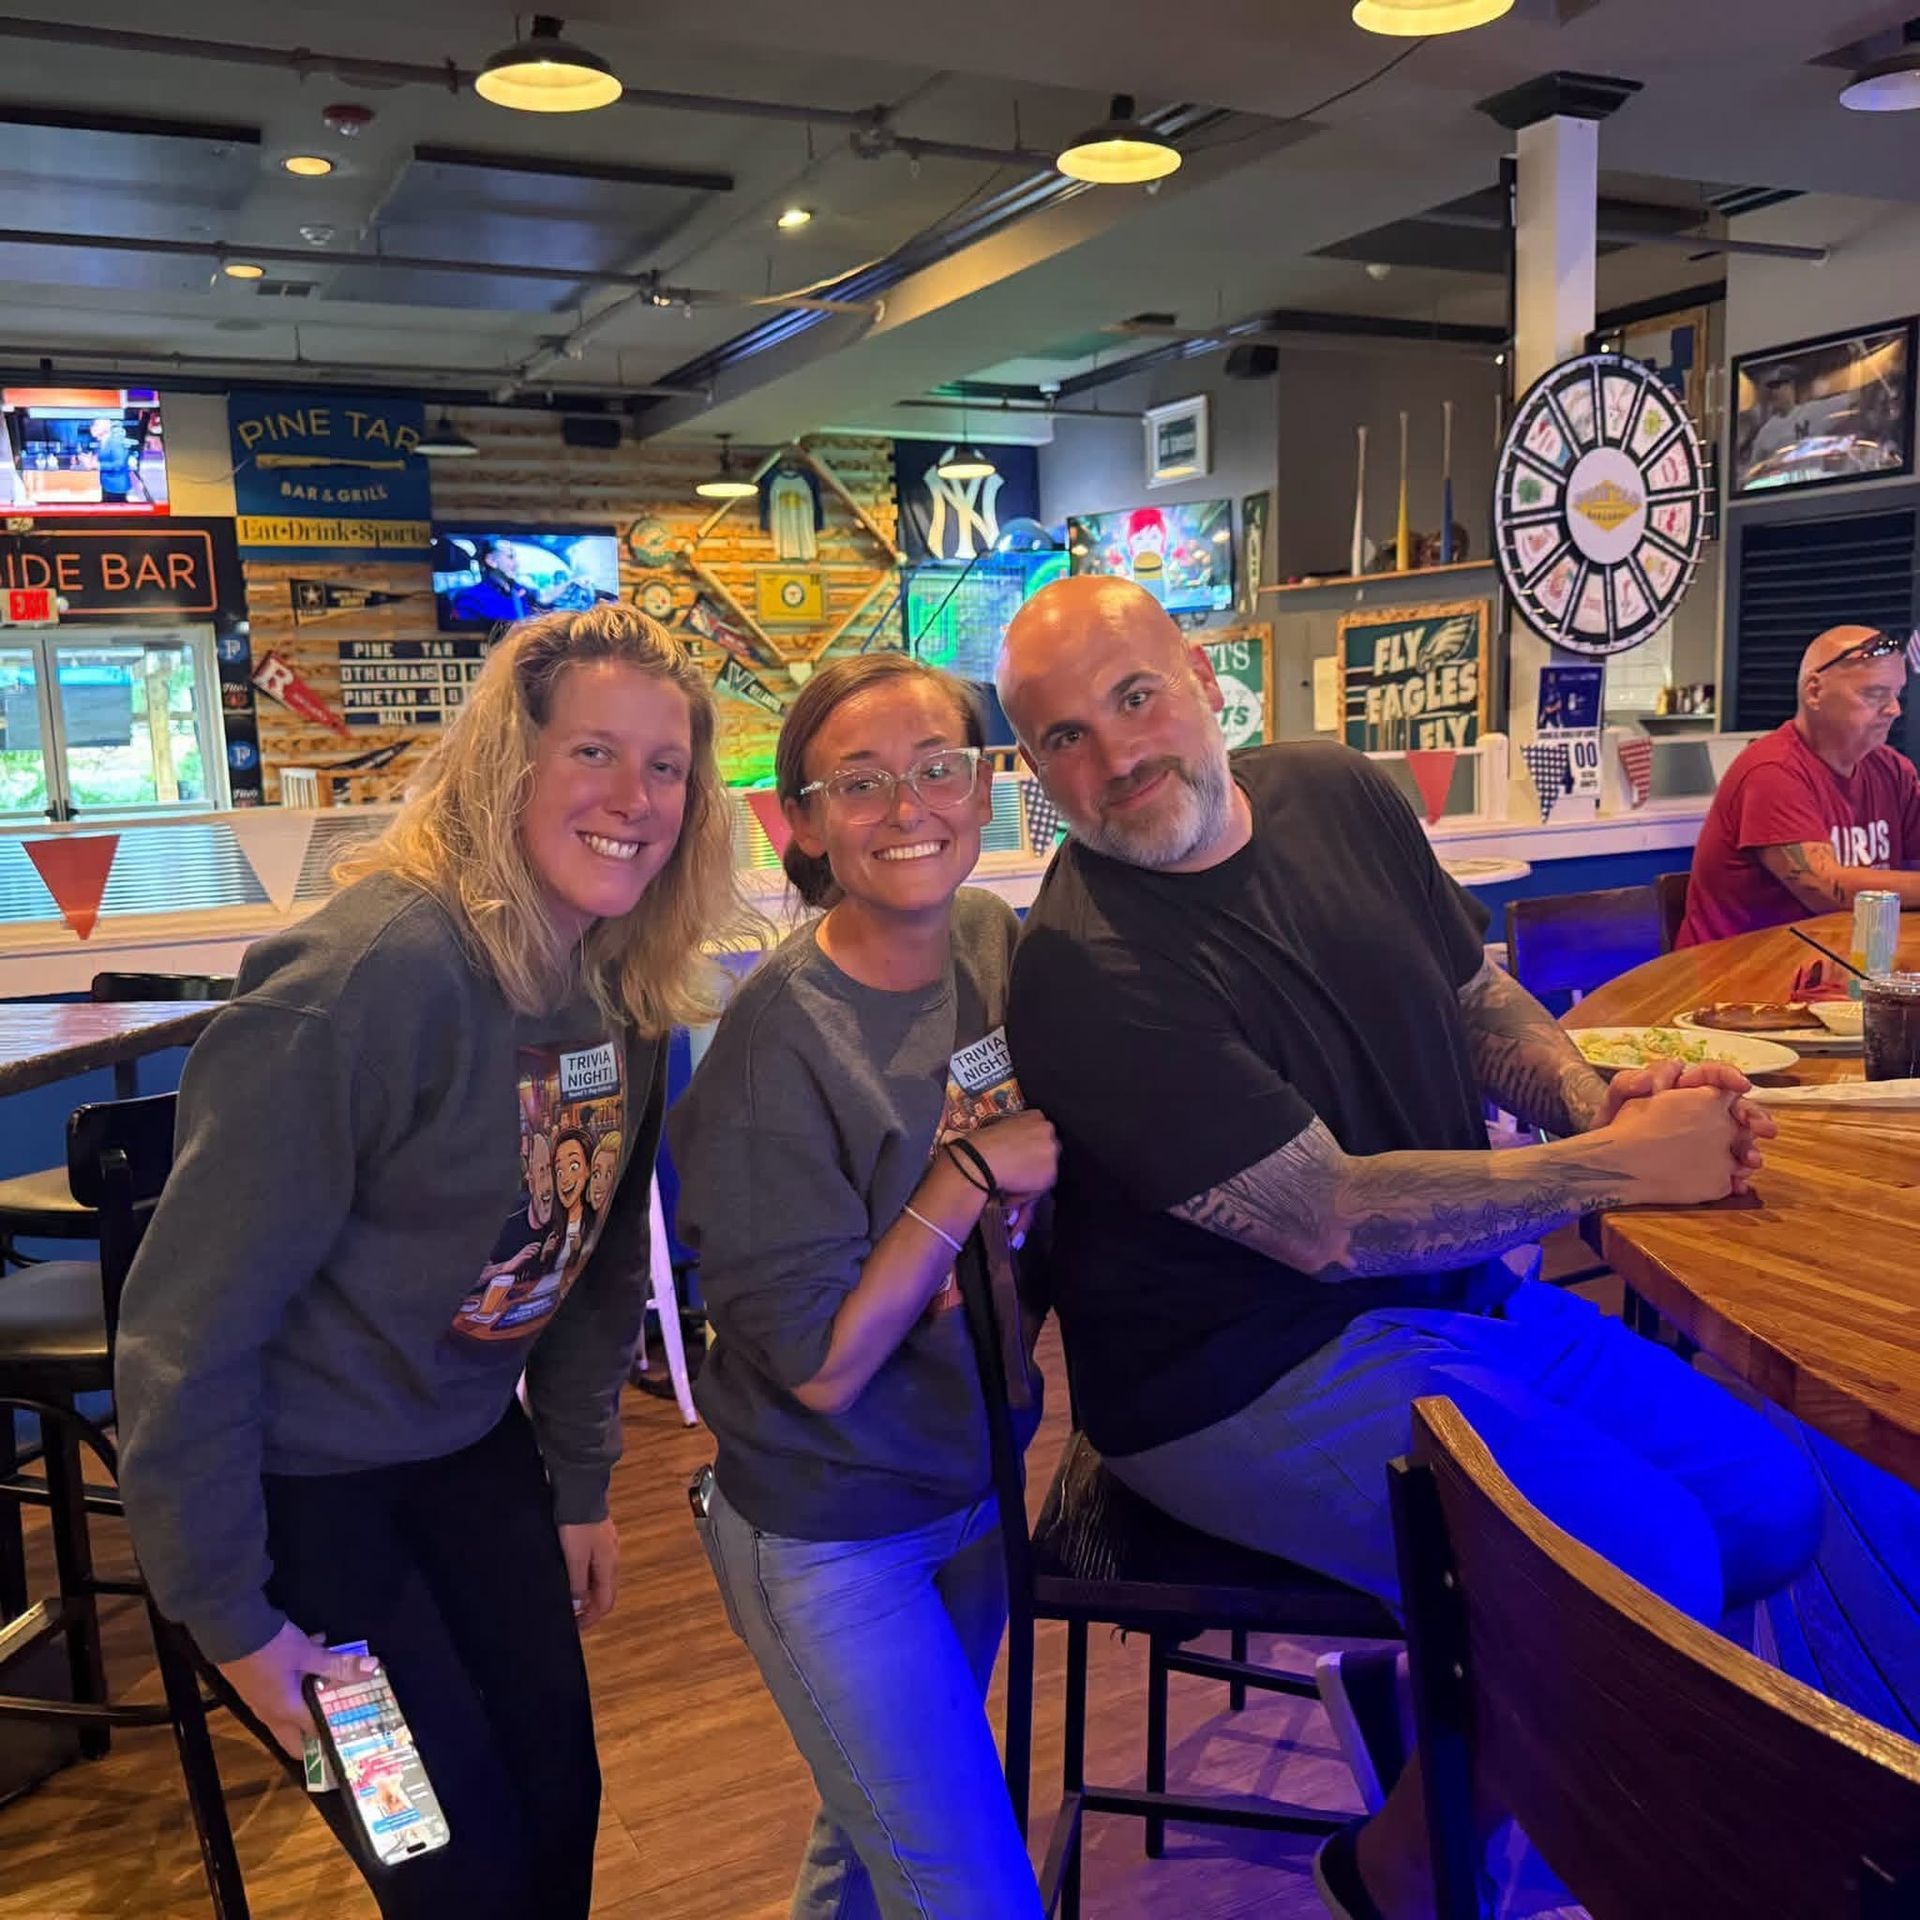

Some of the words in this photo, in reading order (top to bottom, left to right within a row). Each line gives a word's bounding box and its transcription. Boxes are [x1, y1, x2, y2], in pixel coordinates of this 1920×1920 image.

[238, 409, 331, 449] PINE
[344, 411, 421, 455] TAR
[281, 481, 318, 501] BAR
[322, 486, 333, 502] &
[337, 485, 388, 503] GRILL
[0, 553, 84, 591] IDE
[101, 553, 197, 591] BAR
[353, 641, 394, 658] PINE
[421, 641, 454, 657] TAR
[1207, 640, 1250, 673] TS
[1373, 626, 1427, 677] FLY
[344, 690, 417, 705] PINETAR
[1365, 661, 1478, 725] EAGLES
[1221, 705, 1250, 728] TS
[1419, 714, 1472, 749] FLY
[567, 1050, 611, 1071] TRIVIA
[954, 1036, 1006, 1069] TRIVIA
[568, 1066, 613, 1088] NIGHT!
